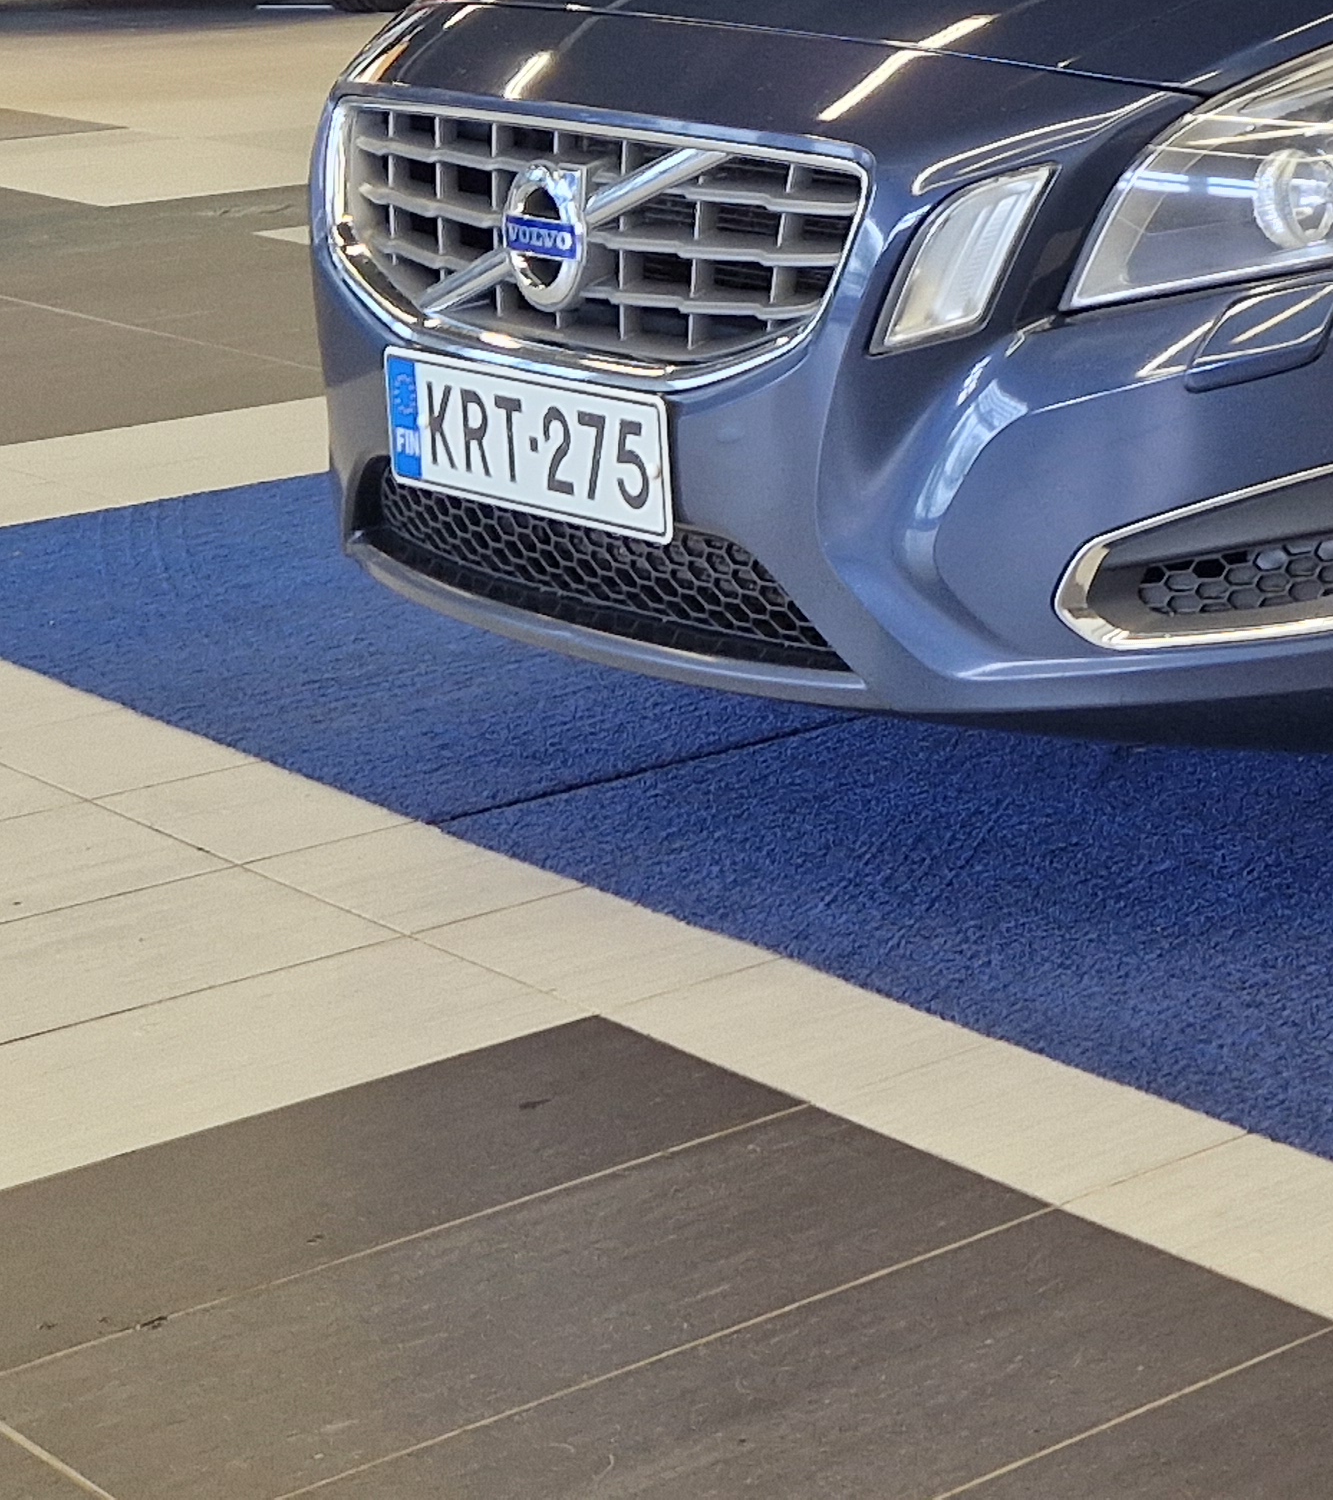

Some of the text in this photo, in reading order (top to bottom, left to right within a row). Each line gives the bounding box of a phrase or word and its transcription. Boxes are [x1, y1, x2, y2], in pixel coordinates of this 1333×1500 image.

[508, 222, 572, 250] VOLVO
[395, 427, 421, 457] FIN
[426, 381, 651, 510] KRT-275
